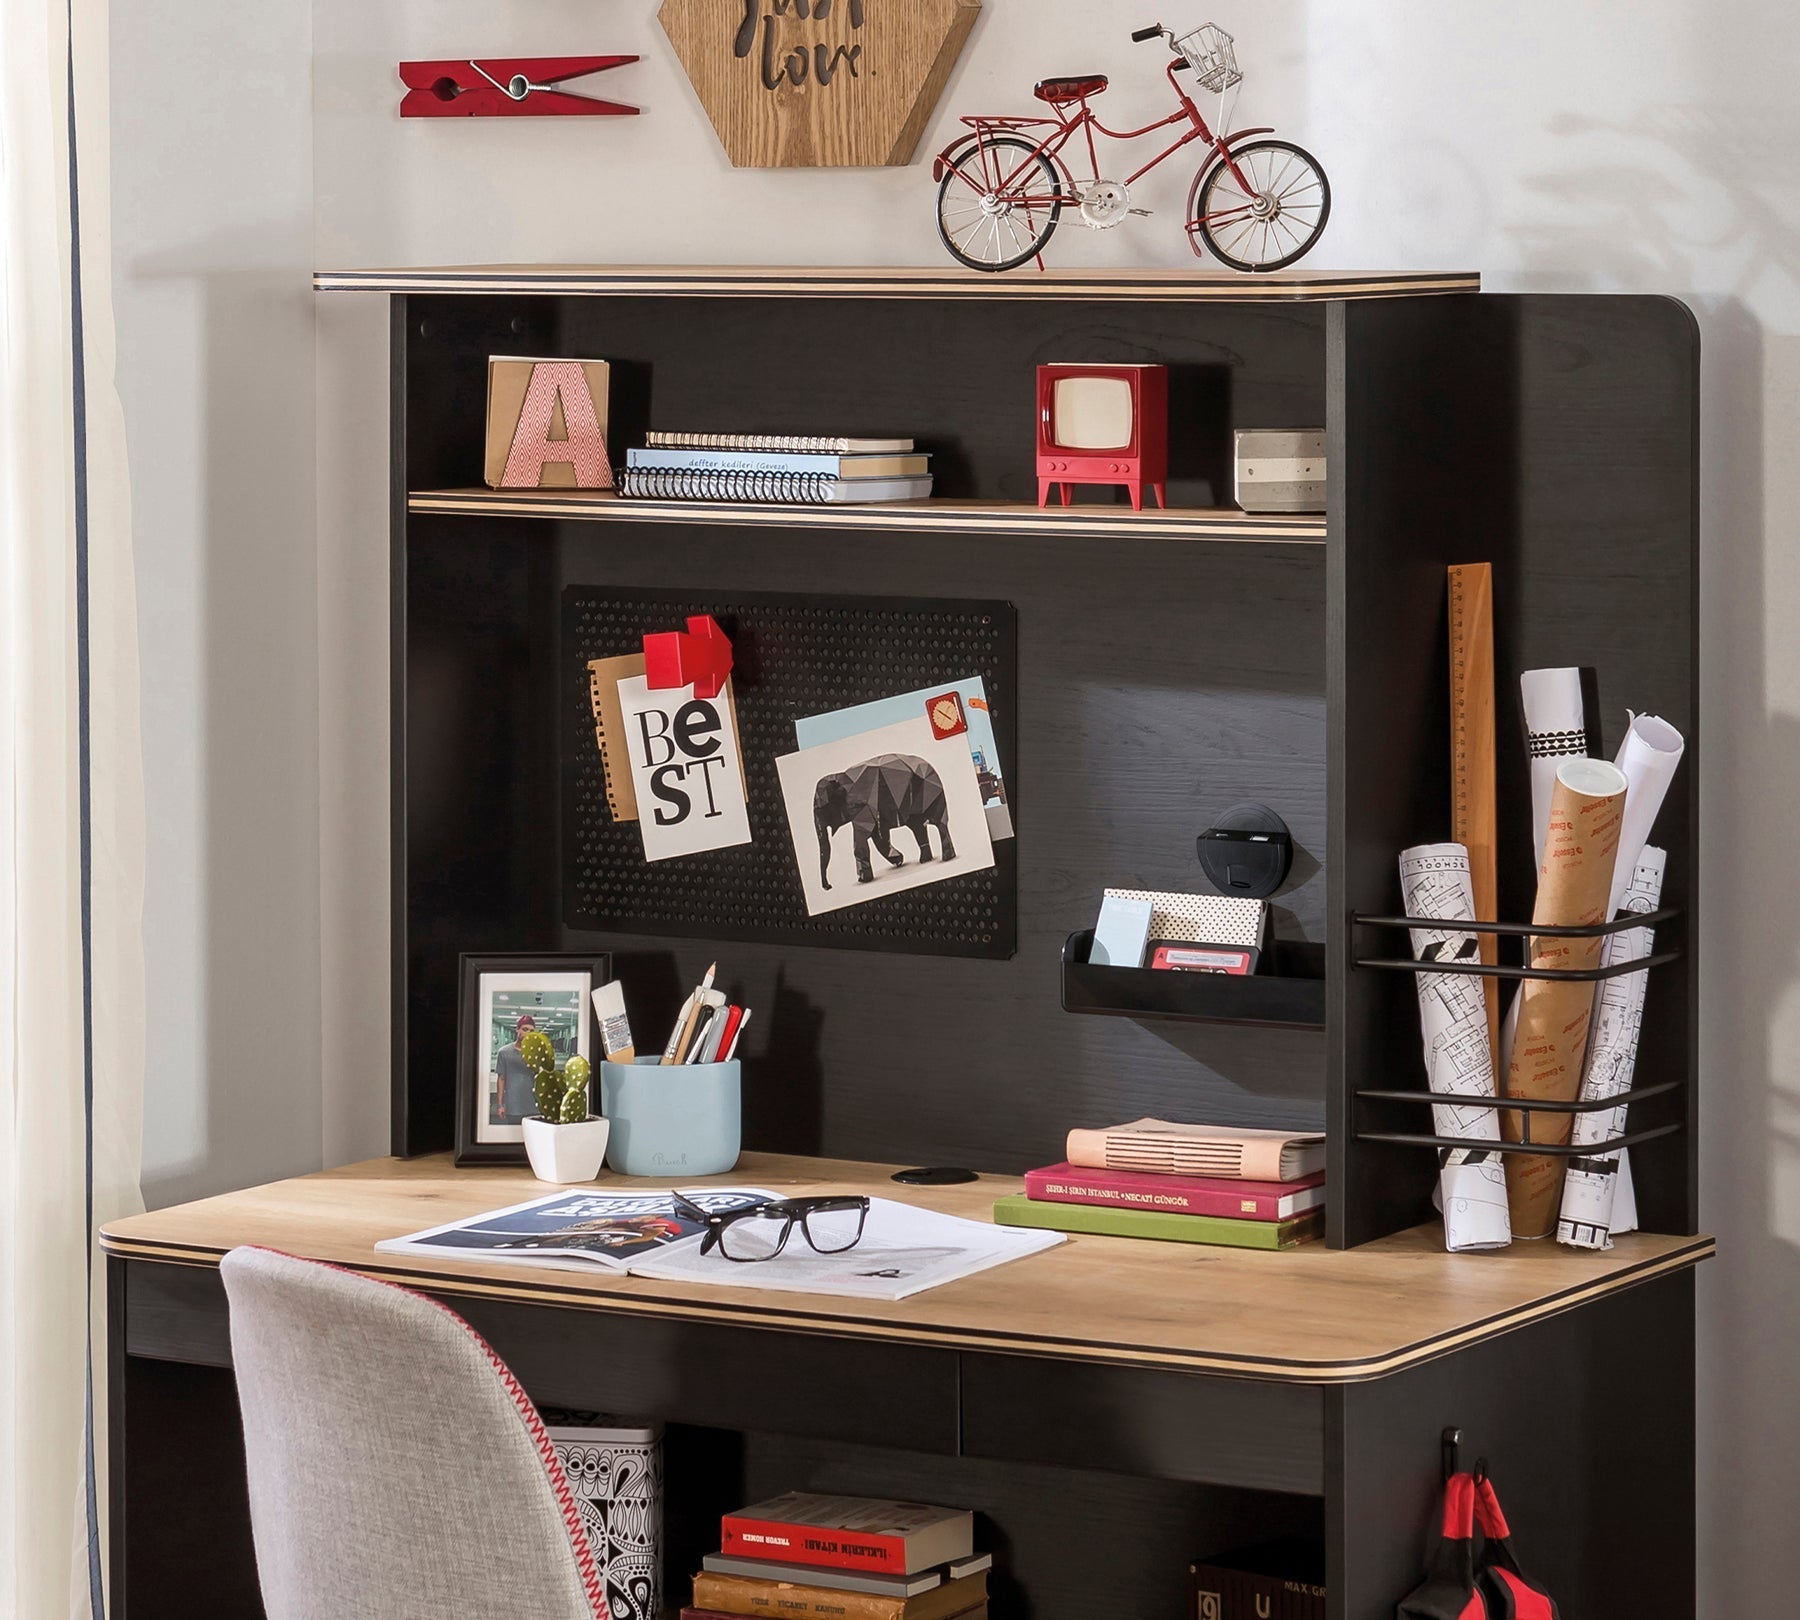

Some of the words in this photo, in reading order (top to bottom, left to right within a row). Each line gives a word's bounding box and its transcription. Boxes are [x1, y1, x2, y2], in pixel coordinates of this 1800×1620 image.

[500, 362, 613, 488] A
[721, 460, 754, 469] kedileri
[1418, 862, 1465, 870] SCHOOL
[1124, 1193, 1153, 1203] NECATİ
[1154, 1195, 1189, 1206] GÜNGÖR
[742, 1533, 765, 1544] HOMER
[765, 1536, 790, 1546] TREVOR
[1284, 1581, 1308, 1594] MAX
